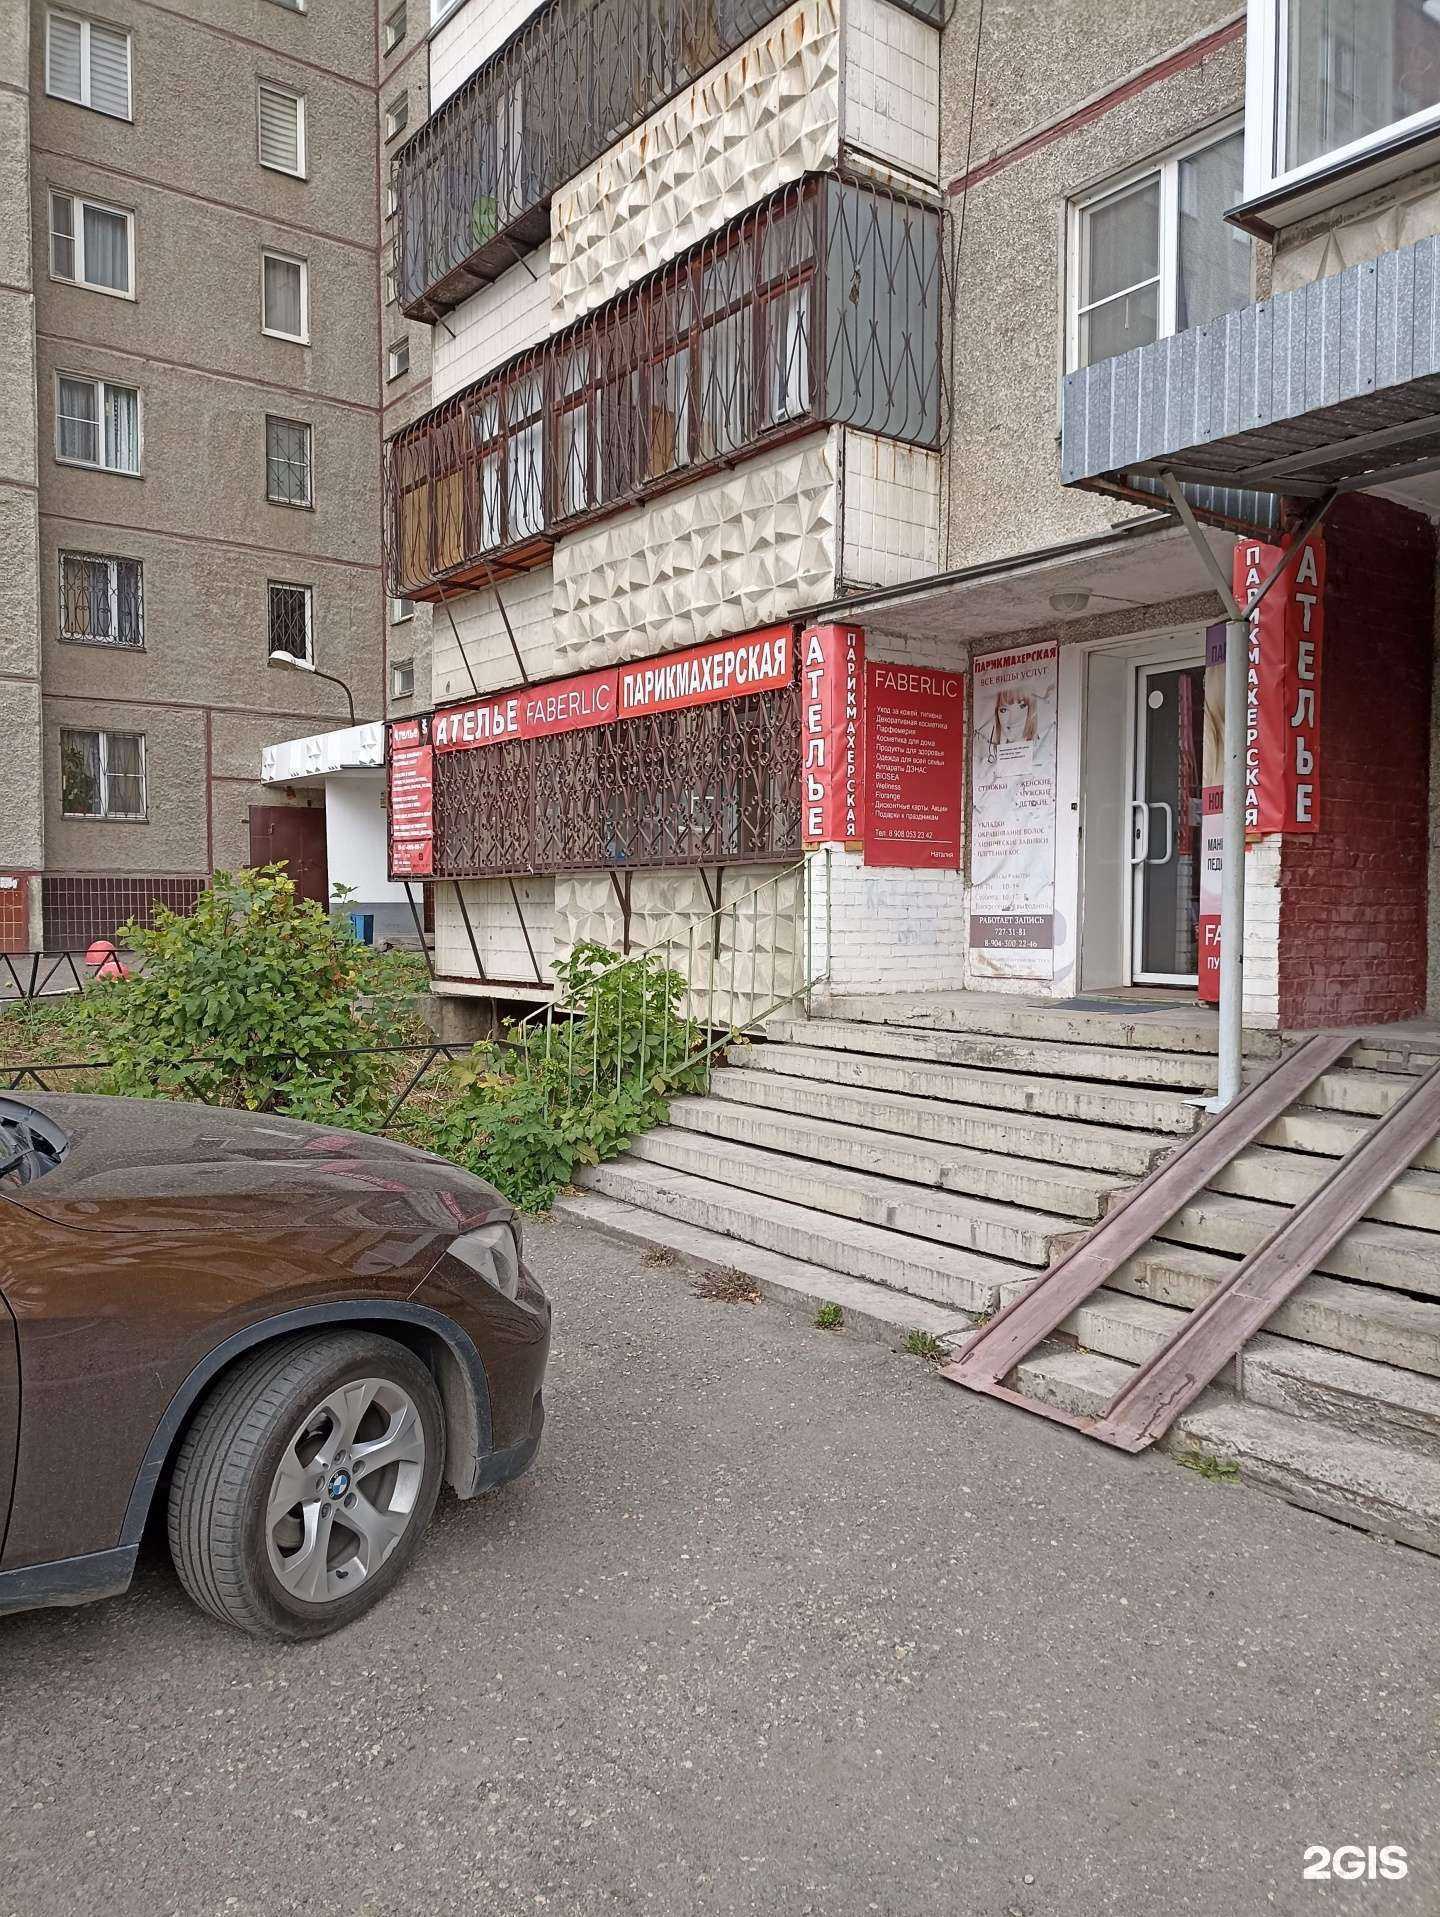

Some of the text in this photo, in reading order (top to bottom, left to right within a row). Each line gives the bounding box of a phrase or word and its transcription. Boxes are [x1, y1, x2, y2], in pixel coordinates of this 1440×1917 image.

[974, 646, 1057, 674] ПАРИКМАХЕРСКАЯ
[1211, 645, 1226, 662] ПА
[622, 637, 788, 709] ПАРИКМАХЕРСКАЯ
[995, 672, 1019, 684] ВИДЫ
[1020, 666, 1047, 679] УСЛУГ
[875, 669, 958, 698] FABERLIC
[1290, 545, 1318, 823] АТЕЛЬЕ
[526, 684, 610, 726] FABERLIC
[435, 698, 519, 747] АТЕЛЬЕ
[876, 714, 948, 730] Декоративная косметика
[876, 724, 917, 735] Парфюмерия
[804, 634, 826, 836] АТЕЛЬЕ
[845, 632, 858, 836] ПАРИКМАХЕРСКАЯ
[876, 734, 936, 748] Косметика для дома
[876, 743, 905, 754] Продукты
[918, 749, 945, 757] здоровья
[876, 753, 900, 763] Одежда
[900, 756, 912, 764] для
[927, 758, 945, 766] семьи
[876, 763, 928, 774] Аппараты ДЭНАС
[875, 772, 900, 781] BIOSEA
[875, 782, 901, 791] Wellness
[875, 791, 901, 802] Florange
[875, 800, 911, 811] Дисконтные
[875, 810, 900, 820] Подарки
[888, 829, 893, 837] 8
[893, 830, 905, 838] 908
[917, 831, 925, 839] 23
[1207, 837, 1223, 852] МАН
[1207, 857, 1222, 872] ПЕД
[979, 916, 1045, 924] РАБОТАЕТ ЗАПИСЬ
